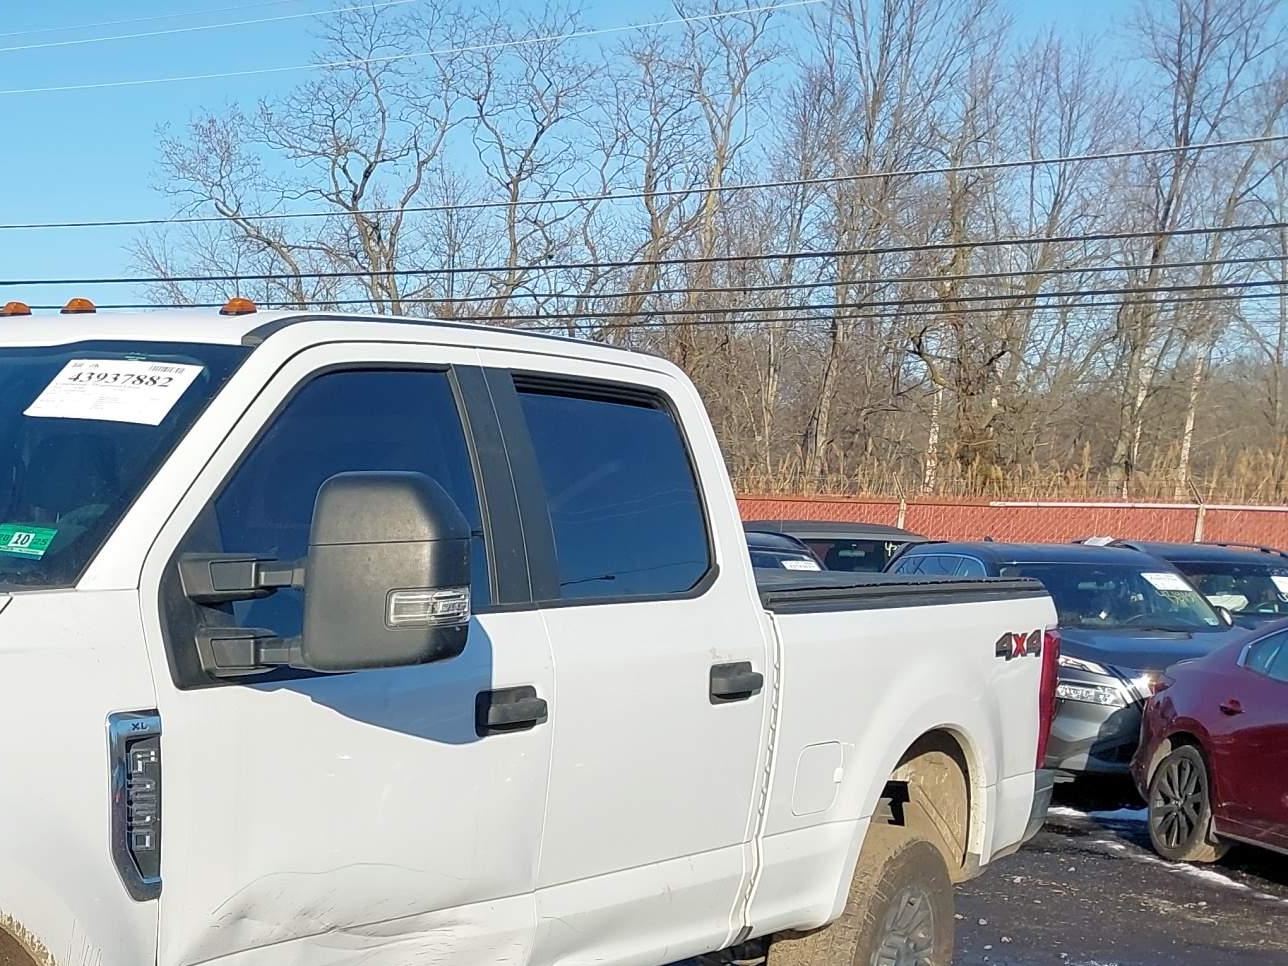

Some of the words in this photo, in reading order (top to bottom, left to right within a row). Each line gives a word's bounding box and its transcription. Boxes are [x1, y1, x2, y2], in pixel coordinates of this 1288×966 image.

[67, 371, 173, 388] 43937882
[12, 533, 31, 546] 10
[131, 721, 148, 731] XL
